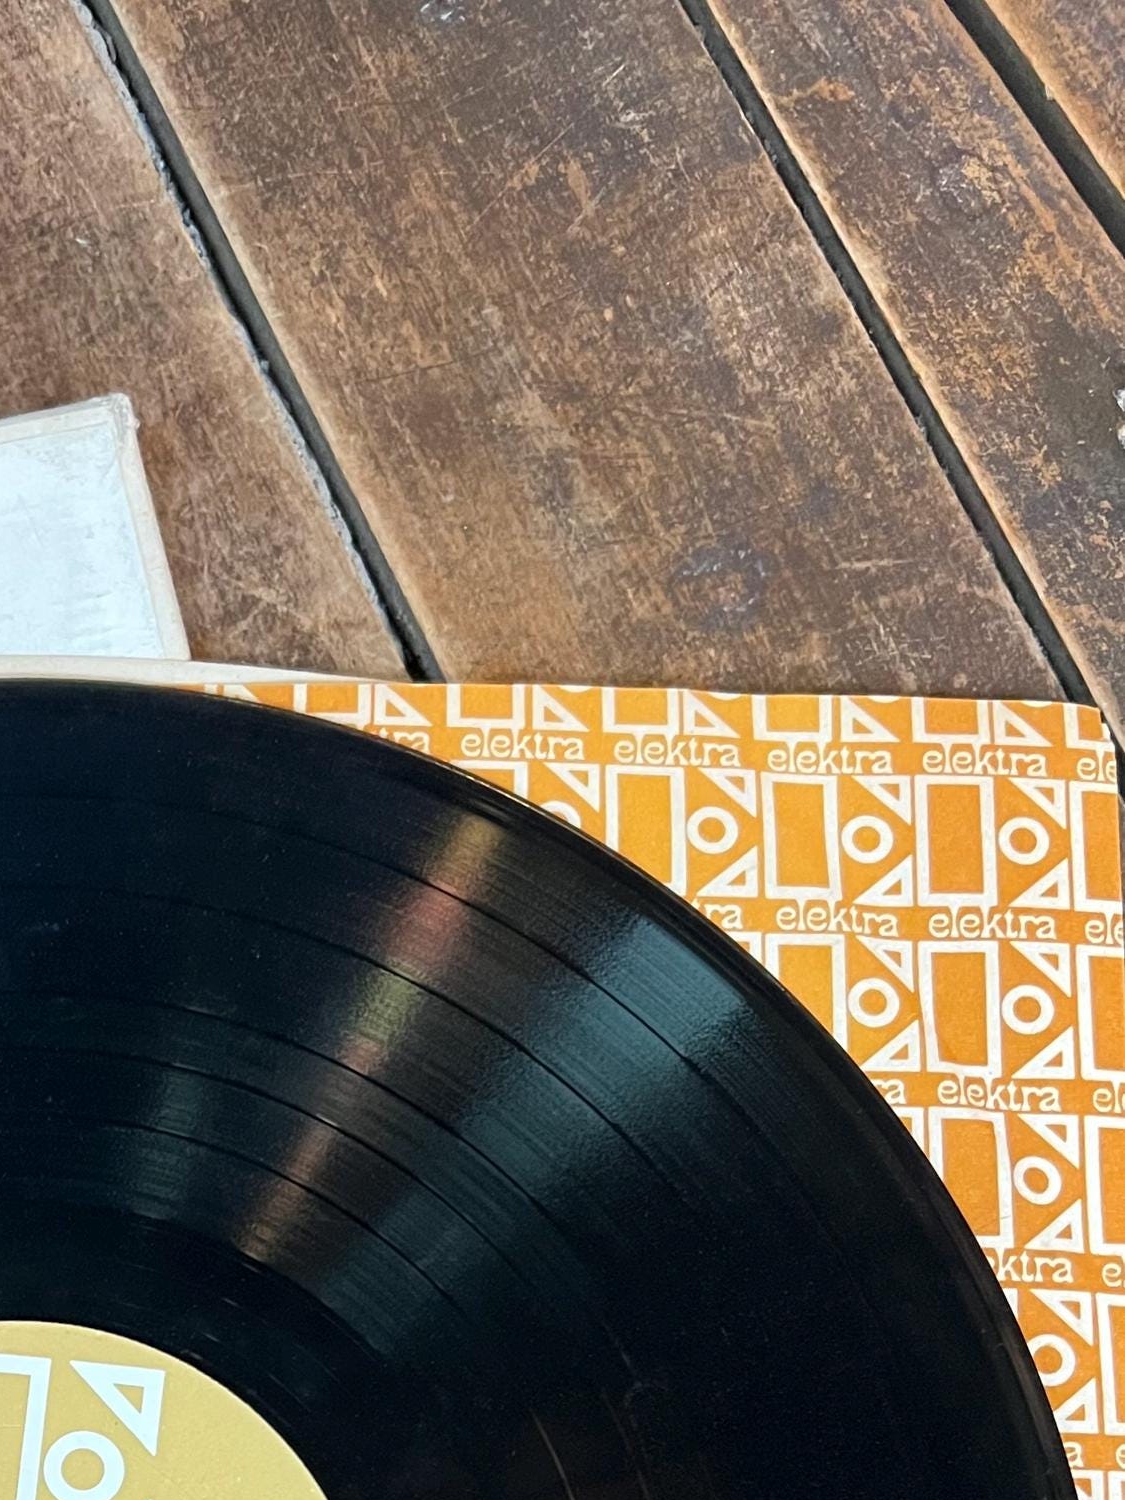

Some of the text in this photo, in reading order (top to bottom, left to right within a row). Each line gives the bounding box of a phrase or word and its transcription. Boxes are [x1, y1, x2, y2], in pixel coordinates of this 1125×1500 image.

[461, 726, 1048, 778] elektra elektra elektra elektra
[776, 900, 1056, 940] elektra elektra
[936, 1076, 1060, 1113] elektra
